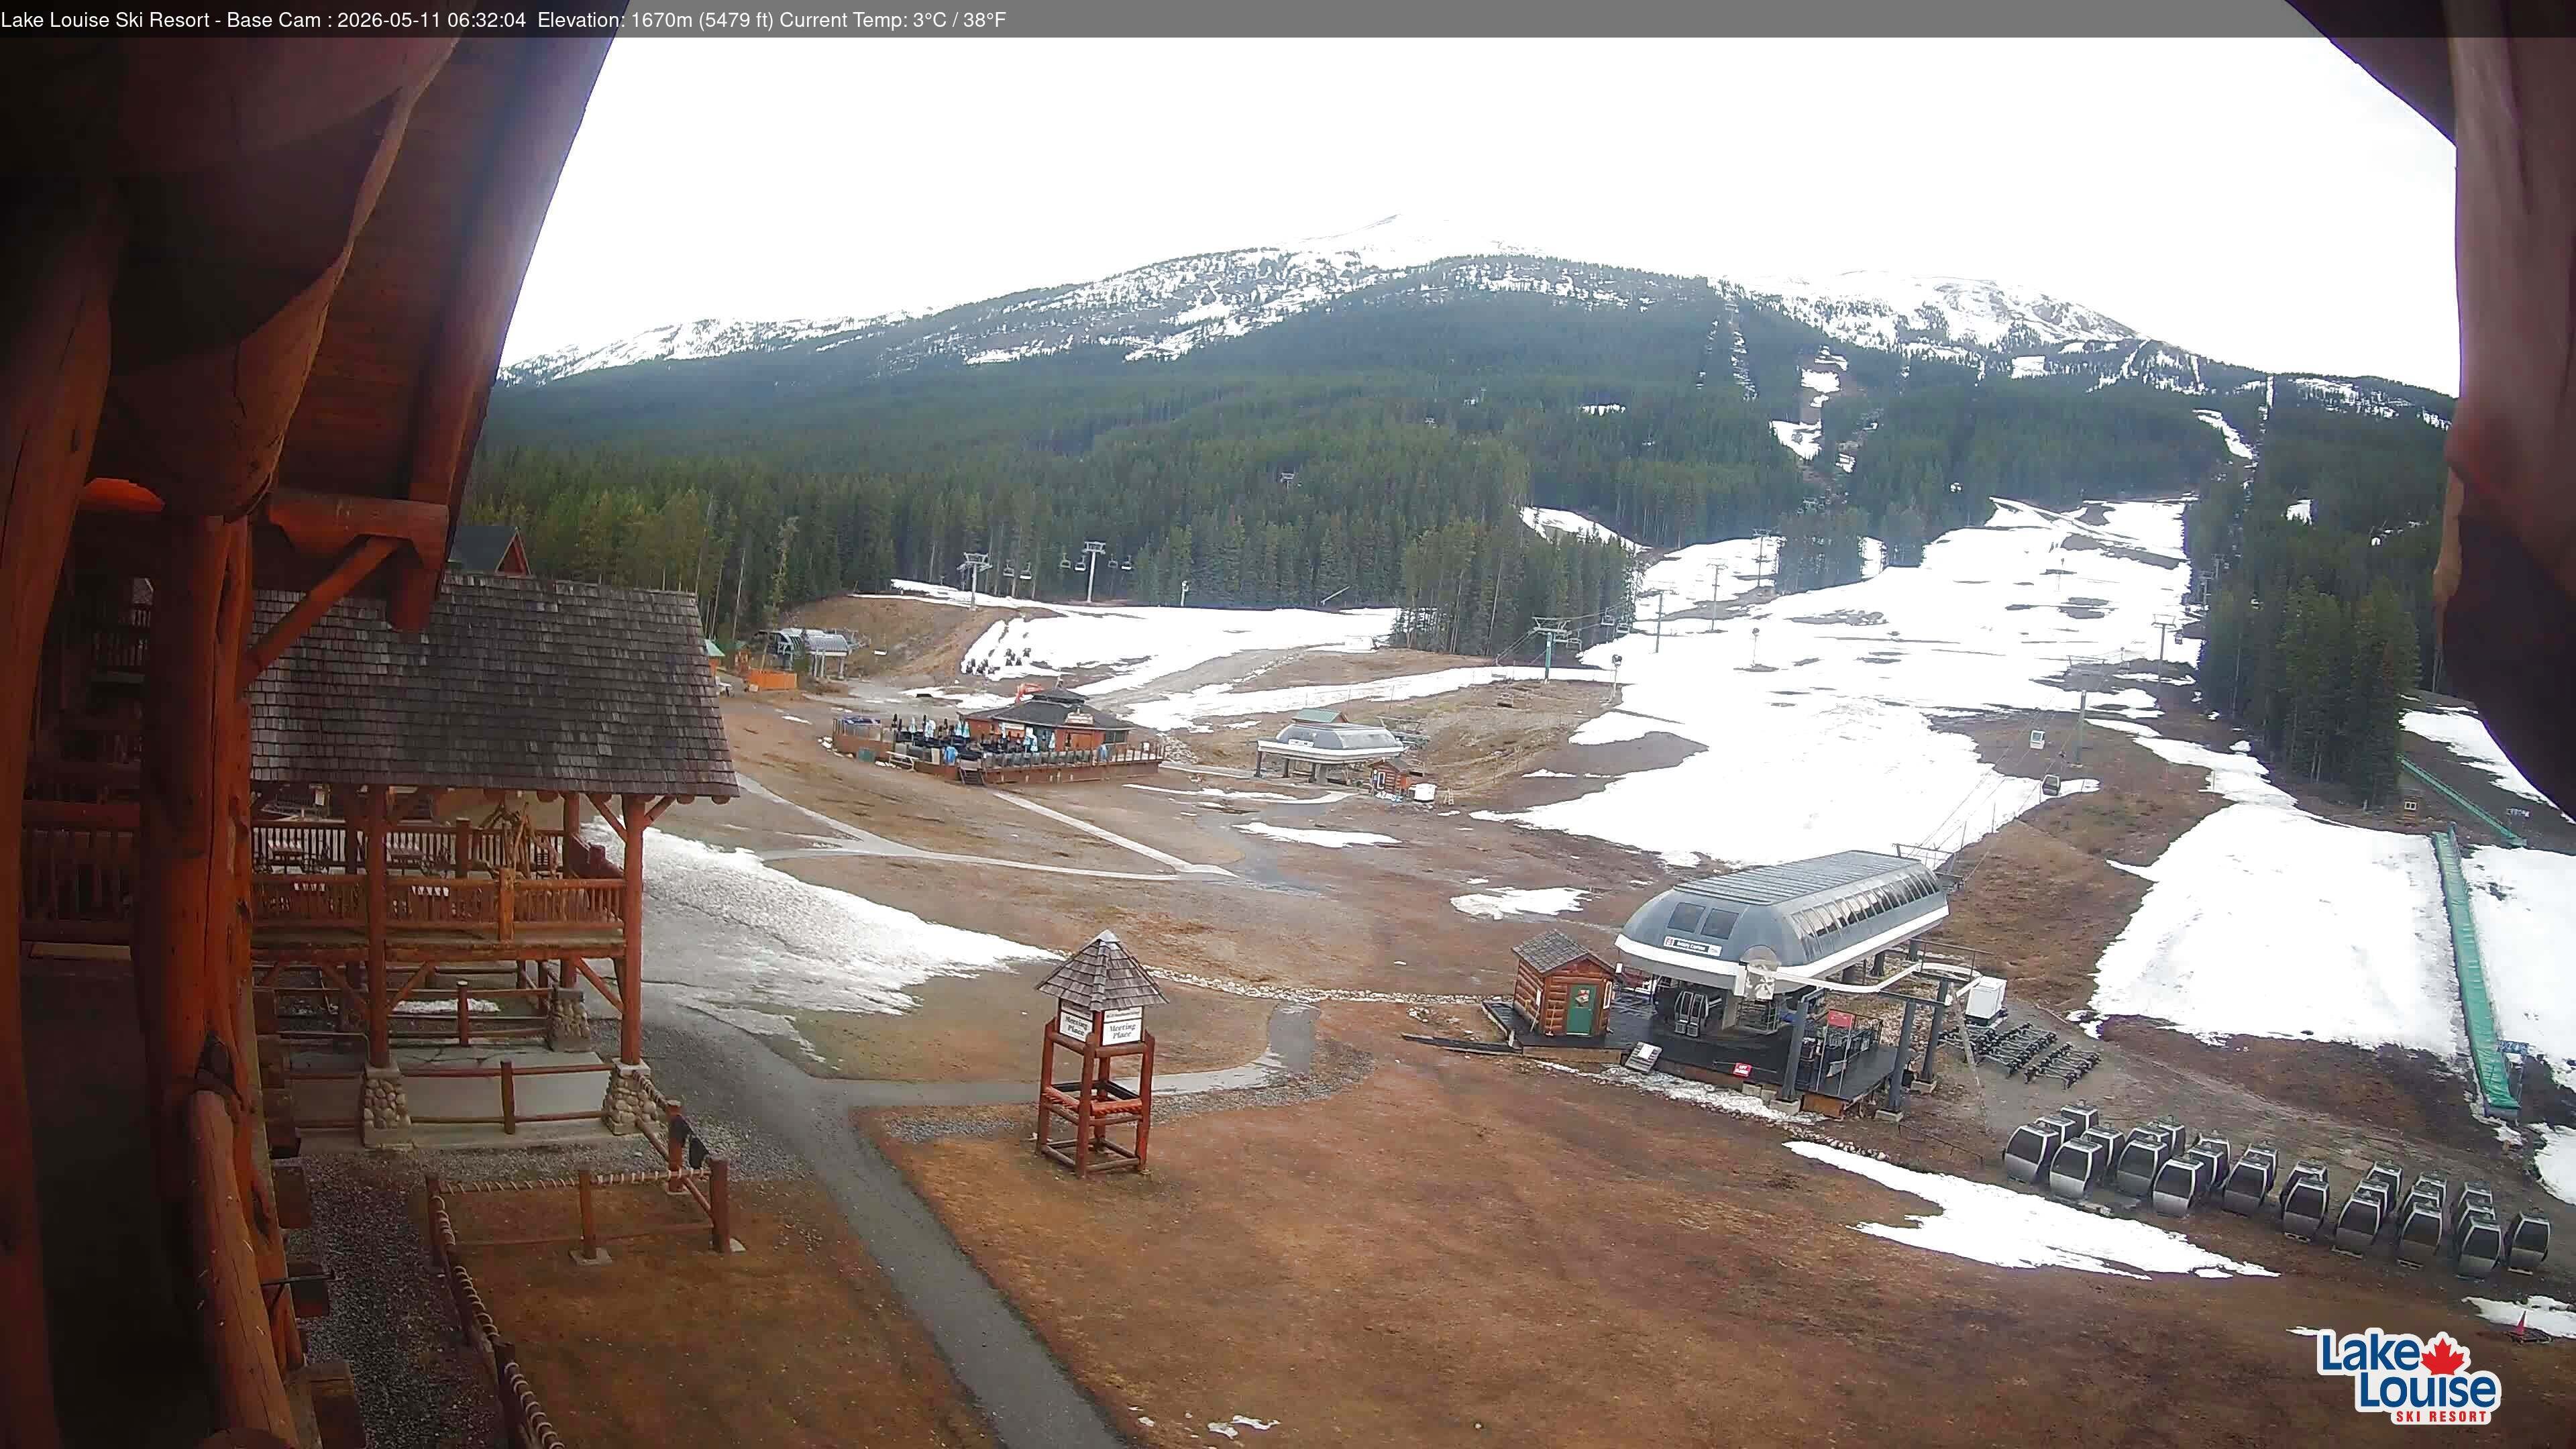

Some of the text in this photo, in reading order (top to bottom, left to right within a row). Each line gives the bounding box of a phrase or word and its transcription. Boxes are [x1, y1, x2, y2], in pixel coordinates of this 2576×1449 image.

[1067, 1025, 1085, 1036] Place
[1110, 1022, 1136, 1032] Meeting
[1113, 1031, 1132, 1039] Place
